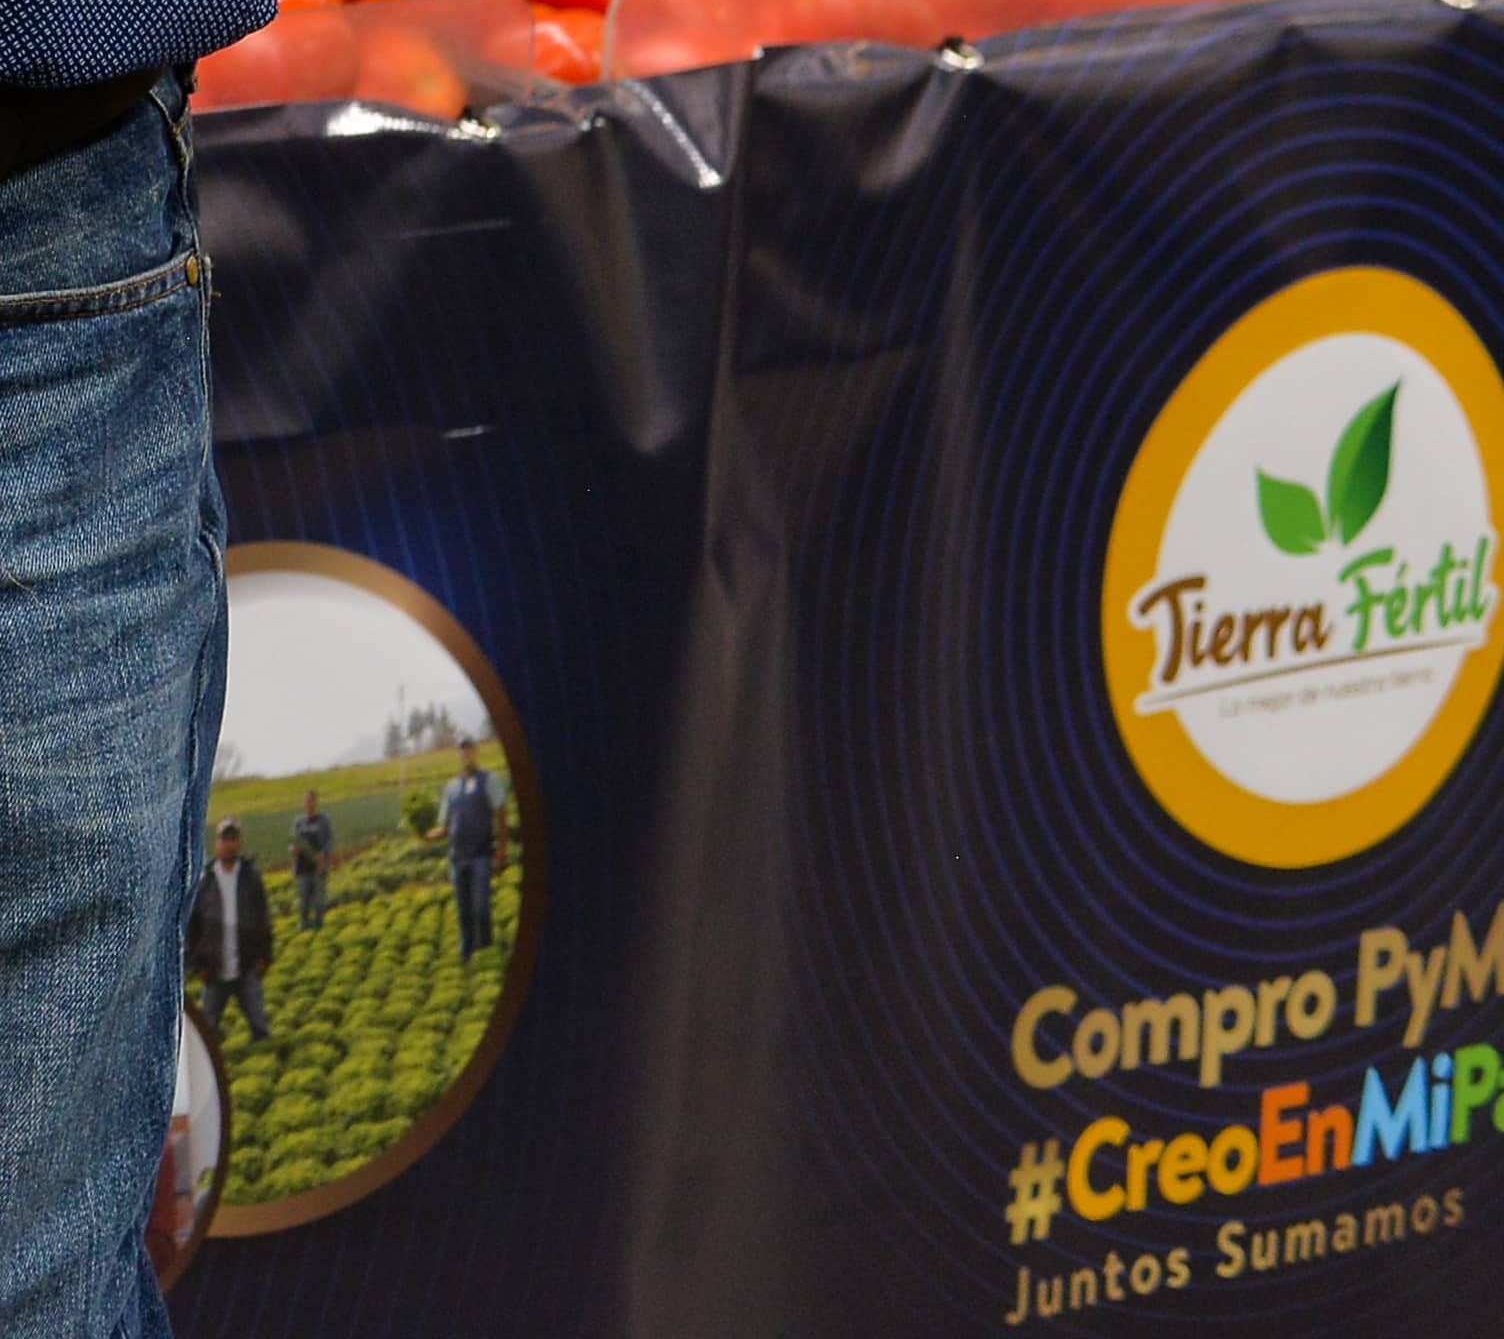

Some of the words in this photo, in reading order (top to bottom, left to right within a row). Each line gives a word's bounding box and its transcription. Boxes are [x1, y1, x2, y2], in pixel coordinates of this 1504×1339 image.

[1138, 575, 1331, 684] Tierra
[1338, 536, 1489, 653] Fértil
[1010, 968, 1338, 1090] Compro
[1004, 1245, 1192, 1327] Juntos
[1215, 1188, 1466, 1280] Sumamos
